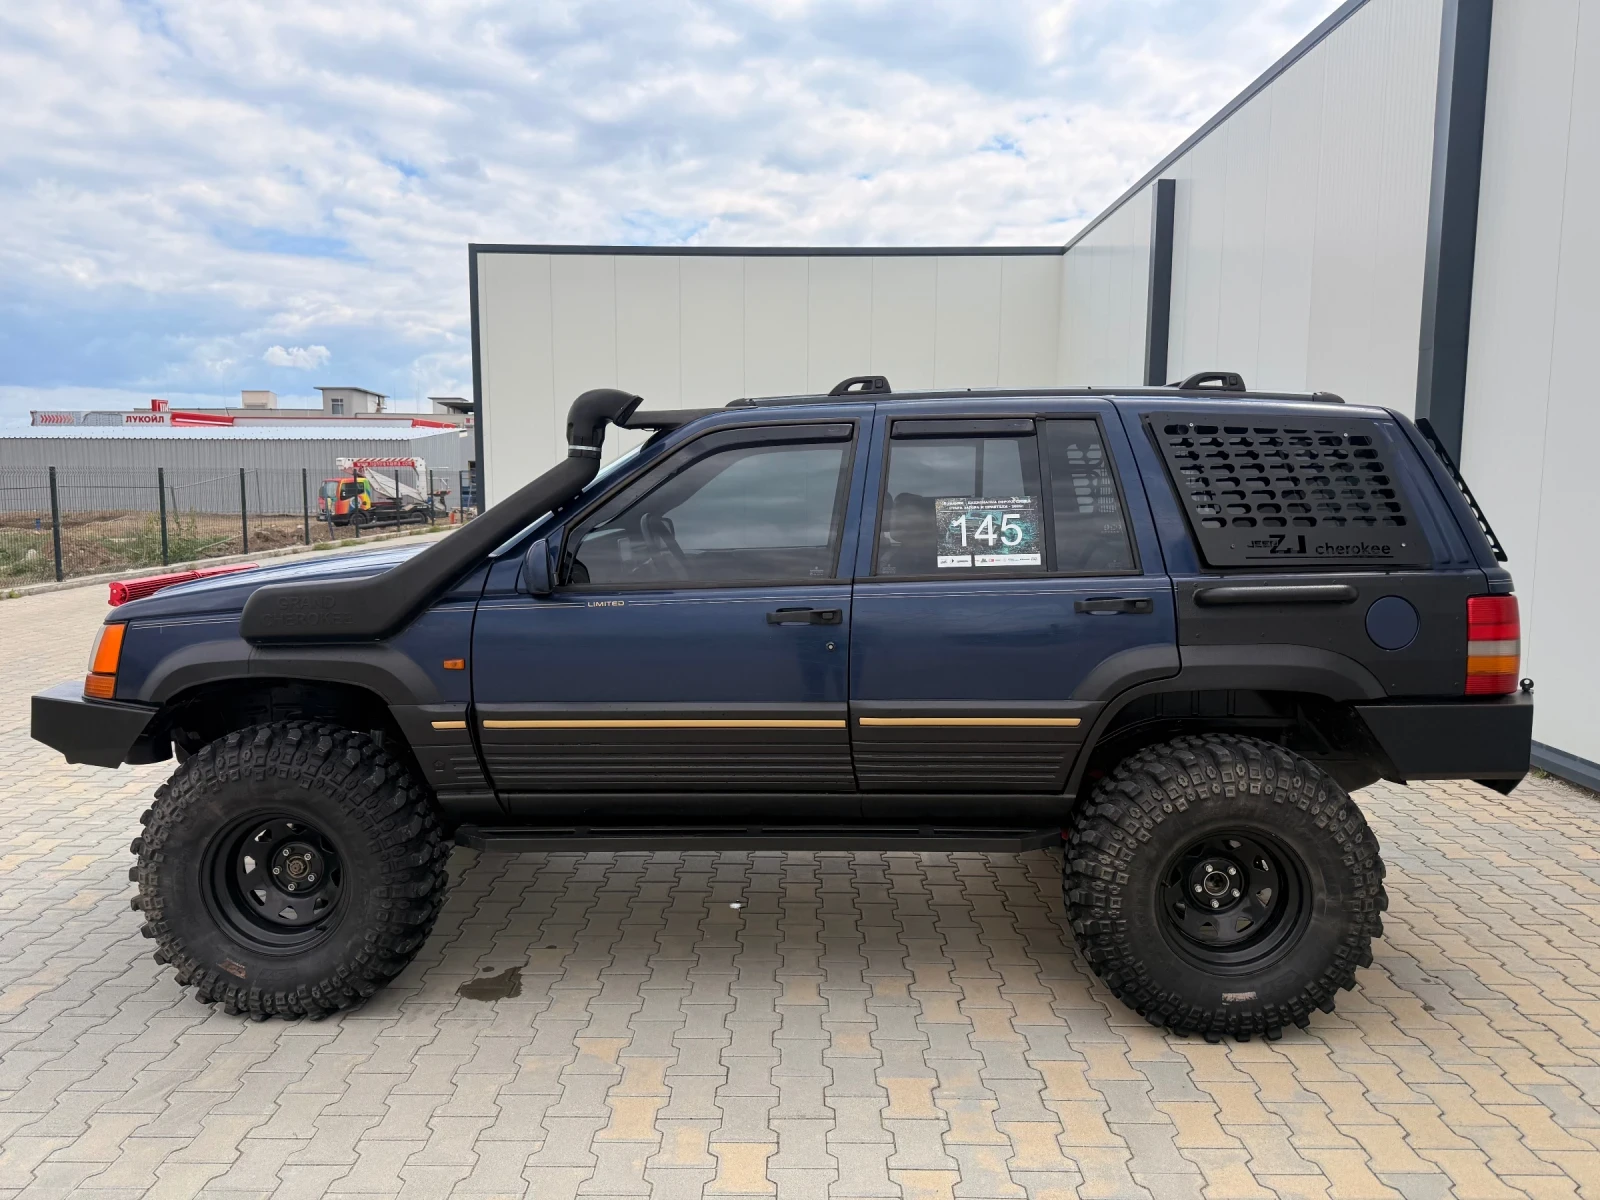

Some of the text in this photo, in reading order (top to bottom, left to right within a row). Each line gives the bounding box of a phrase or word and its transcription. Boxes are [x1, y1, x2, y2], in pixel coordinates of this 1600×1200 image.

[125, 414, 164, 423] ЛУКОЙЛ
[951, 514, 1023, 547] 145
[1315, 542, 1391, 555] cherokee
[279, 597, 336, 610] GRAND
[587, 600, 625, 608] LIMITED
[263, 612, 354, 626] CHEROKEE
